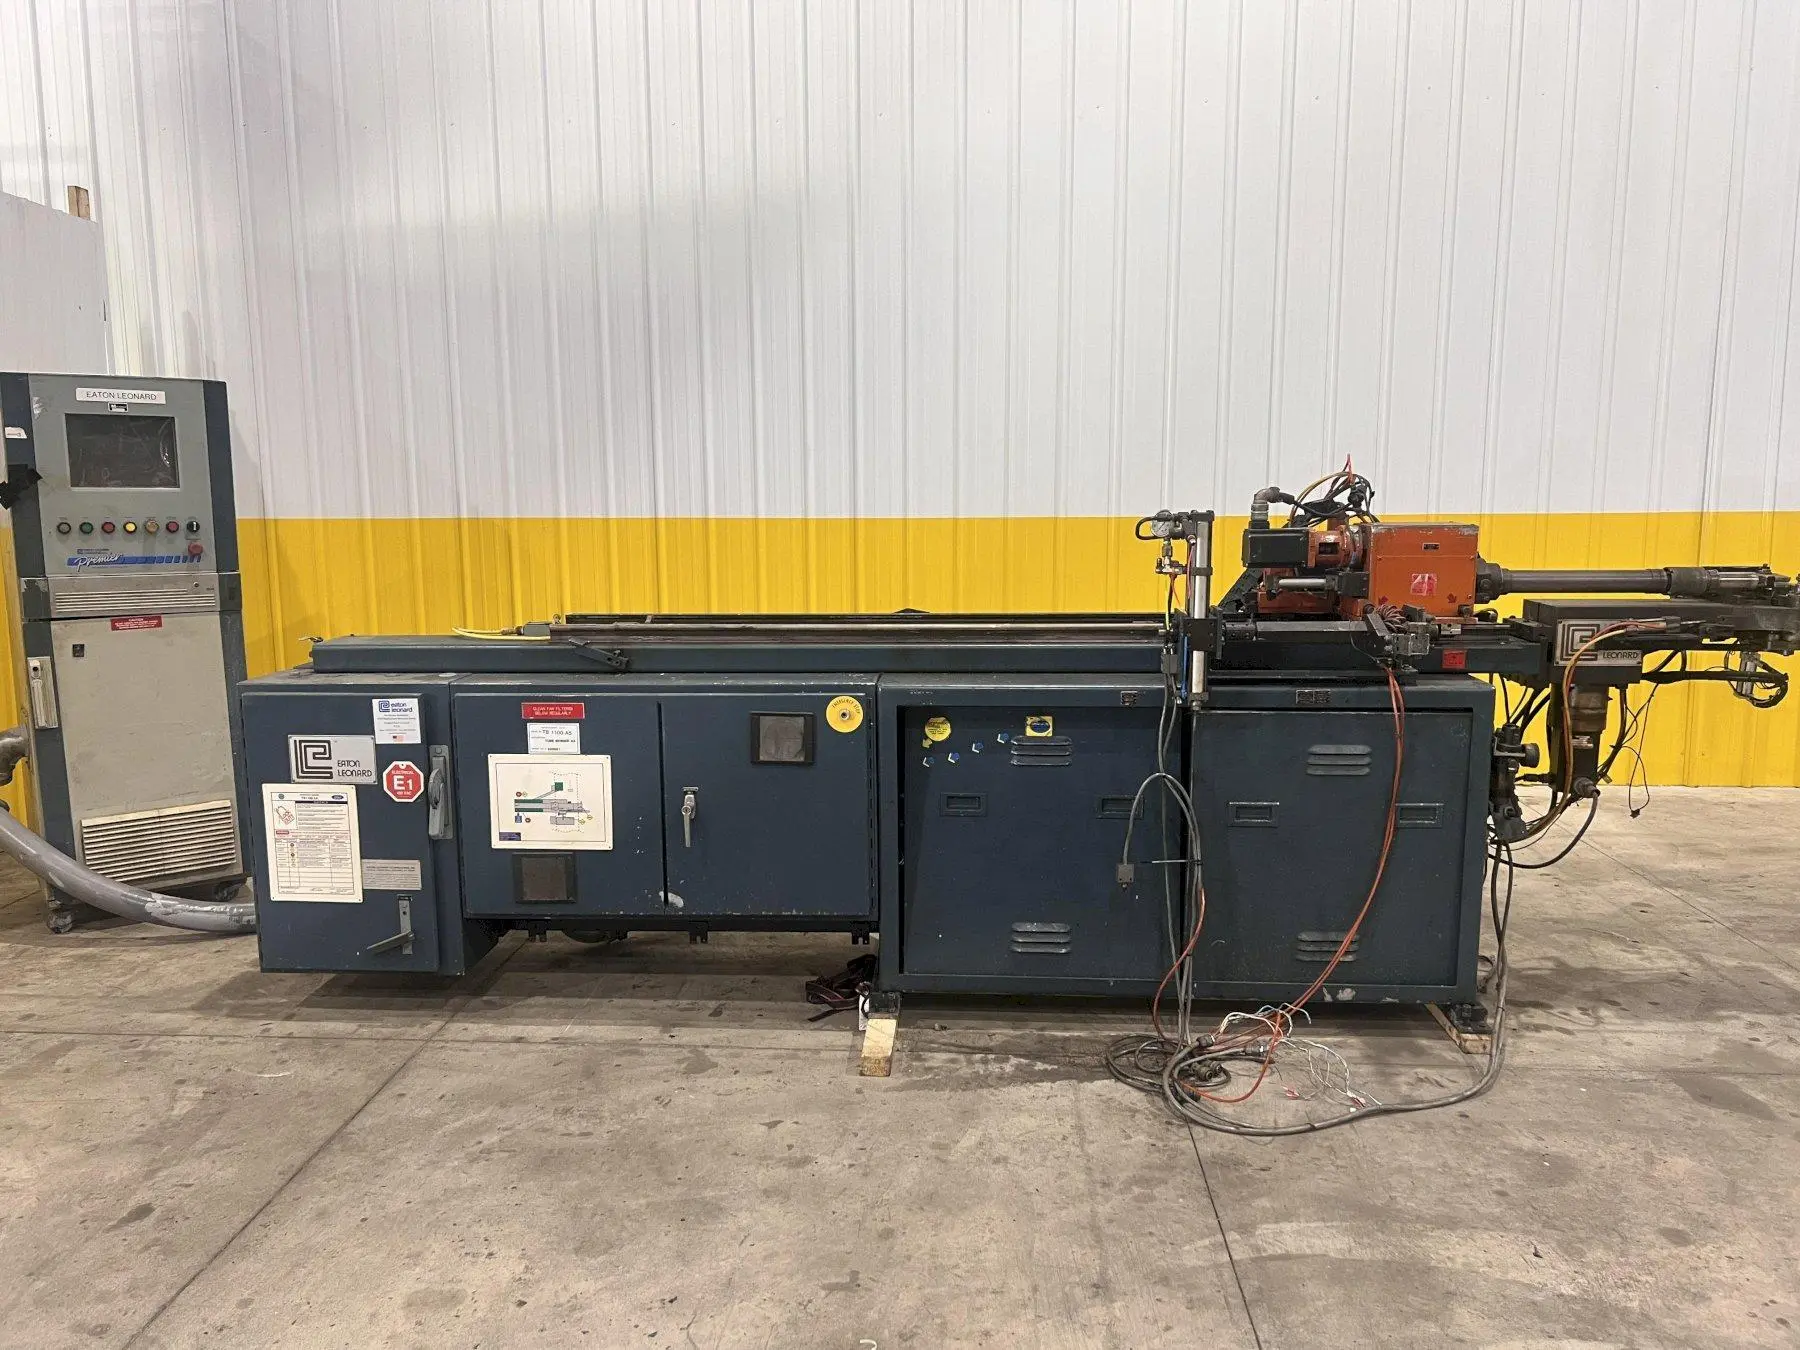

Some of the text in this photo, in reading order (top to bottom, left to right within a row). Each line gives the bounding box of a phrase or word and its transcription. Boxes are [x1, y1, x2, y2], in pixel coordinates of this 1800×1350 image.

[86, 391, 157, 401] EATON LEONARD
[1602, 651, 1638, 659] LEONARD
[336, 760, 361, 768] EATON
[337, 769, 373, 778] LEONARD
